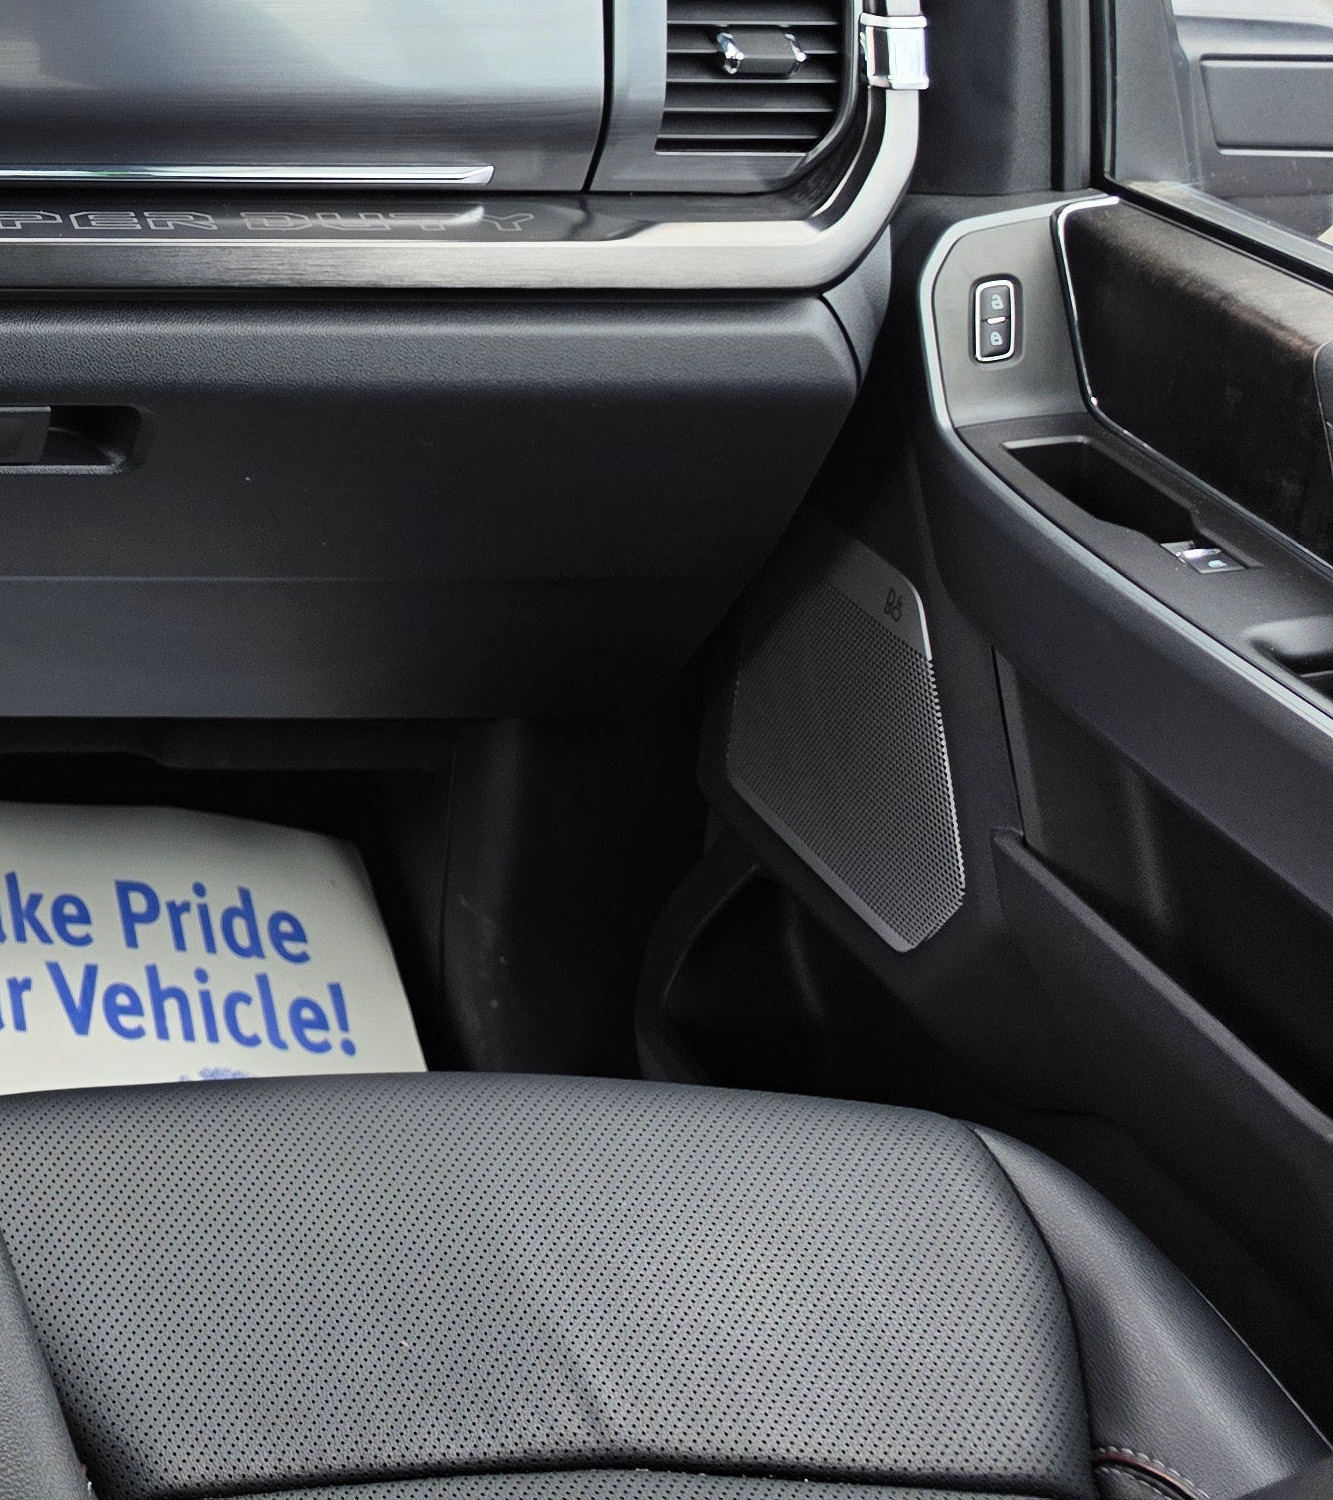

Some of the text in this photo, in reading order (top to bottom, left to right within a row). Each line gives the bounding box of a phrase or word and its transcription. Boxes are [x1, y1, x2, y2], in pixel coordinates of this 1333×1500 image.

[239, 208, 536, 233] DUTY
[114, 879, 312, 965] Pride
[44, 959, 358, 1058] Vehicle!
